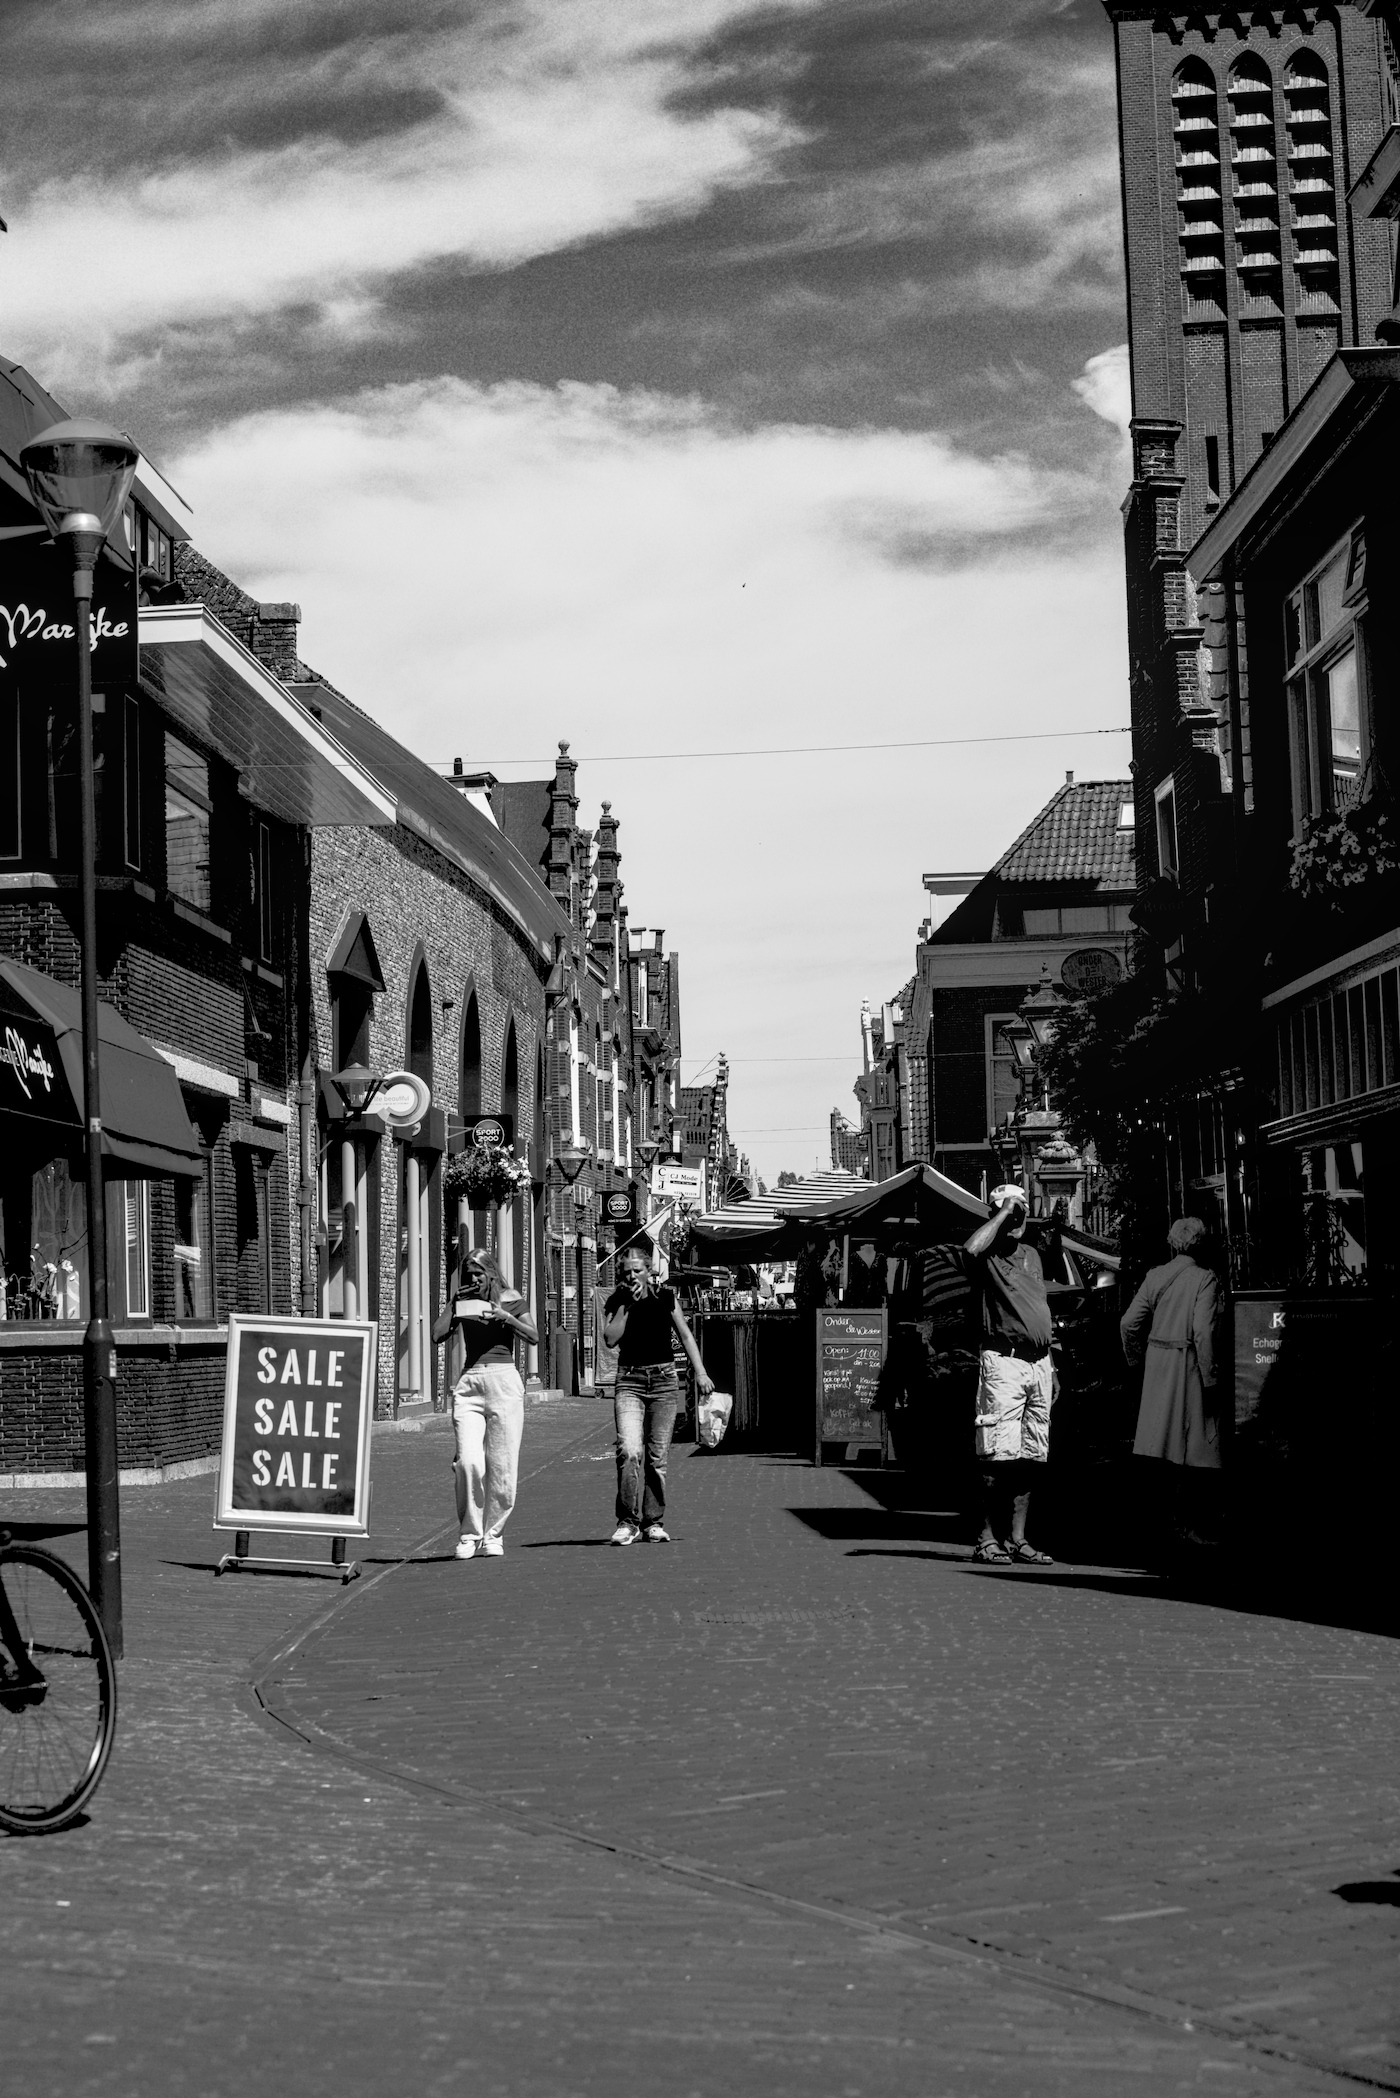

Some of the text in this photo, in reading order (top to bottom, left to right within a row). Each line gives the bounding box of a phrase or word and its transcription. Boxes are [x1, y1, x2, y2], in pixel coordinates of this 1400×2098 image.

[1078, 954, 1103, 966] ONDER
[1077, 975, 1107, 987] WESTER
[257, 1347, 345, 1387] SALE
[254, 1398, 342, 1438] SALE
[252, 1449, 339, 1489] SALE
